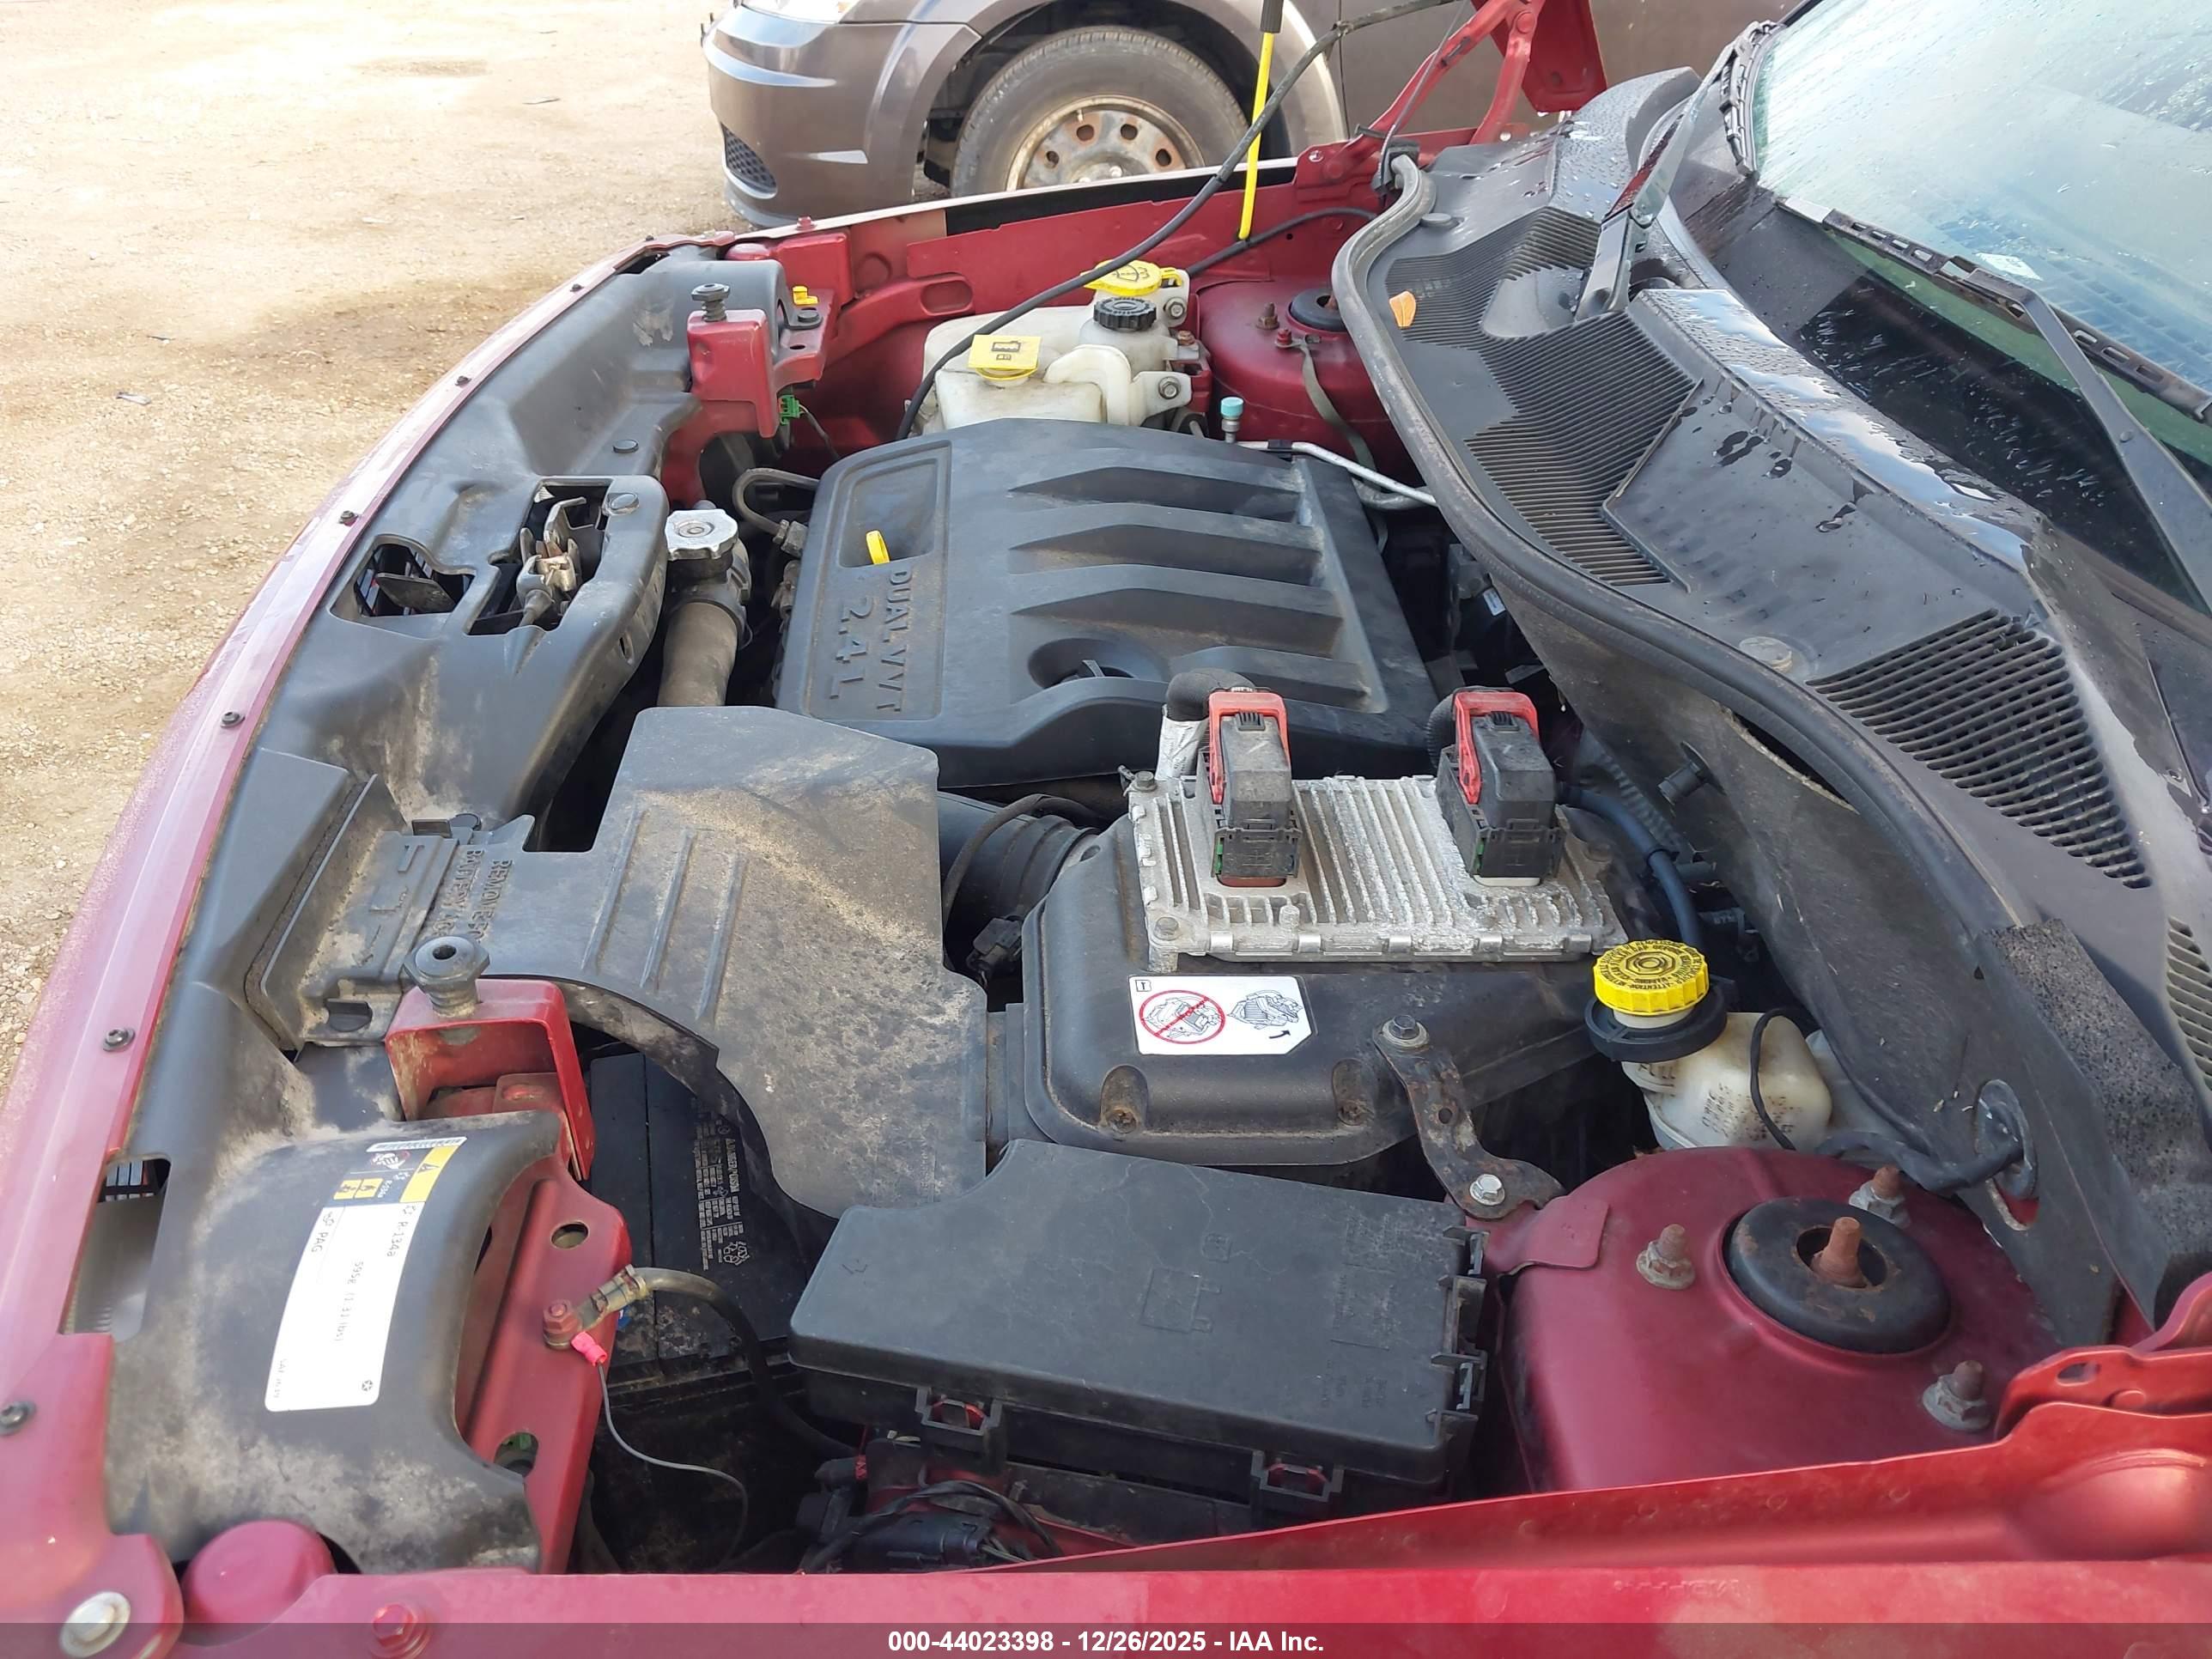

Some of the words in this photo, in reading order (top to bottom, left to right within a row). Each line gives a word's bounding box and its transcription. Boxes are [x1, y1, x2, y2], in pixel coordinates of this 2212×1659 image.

[883, 565, 913, 643] DUAL
[877, 644, 908, 713] VVT
[441, 849, 484, 910] BATTERY
[471, 860, 514, 921] REMOVE
[311, 1231, 329, 1254] PAG
[386, 1221, 408, 1257] R-134a
